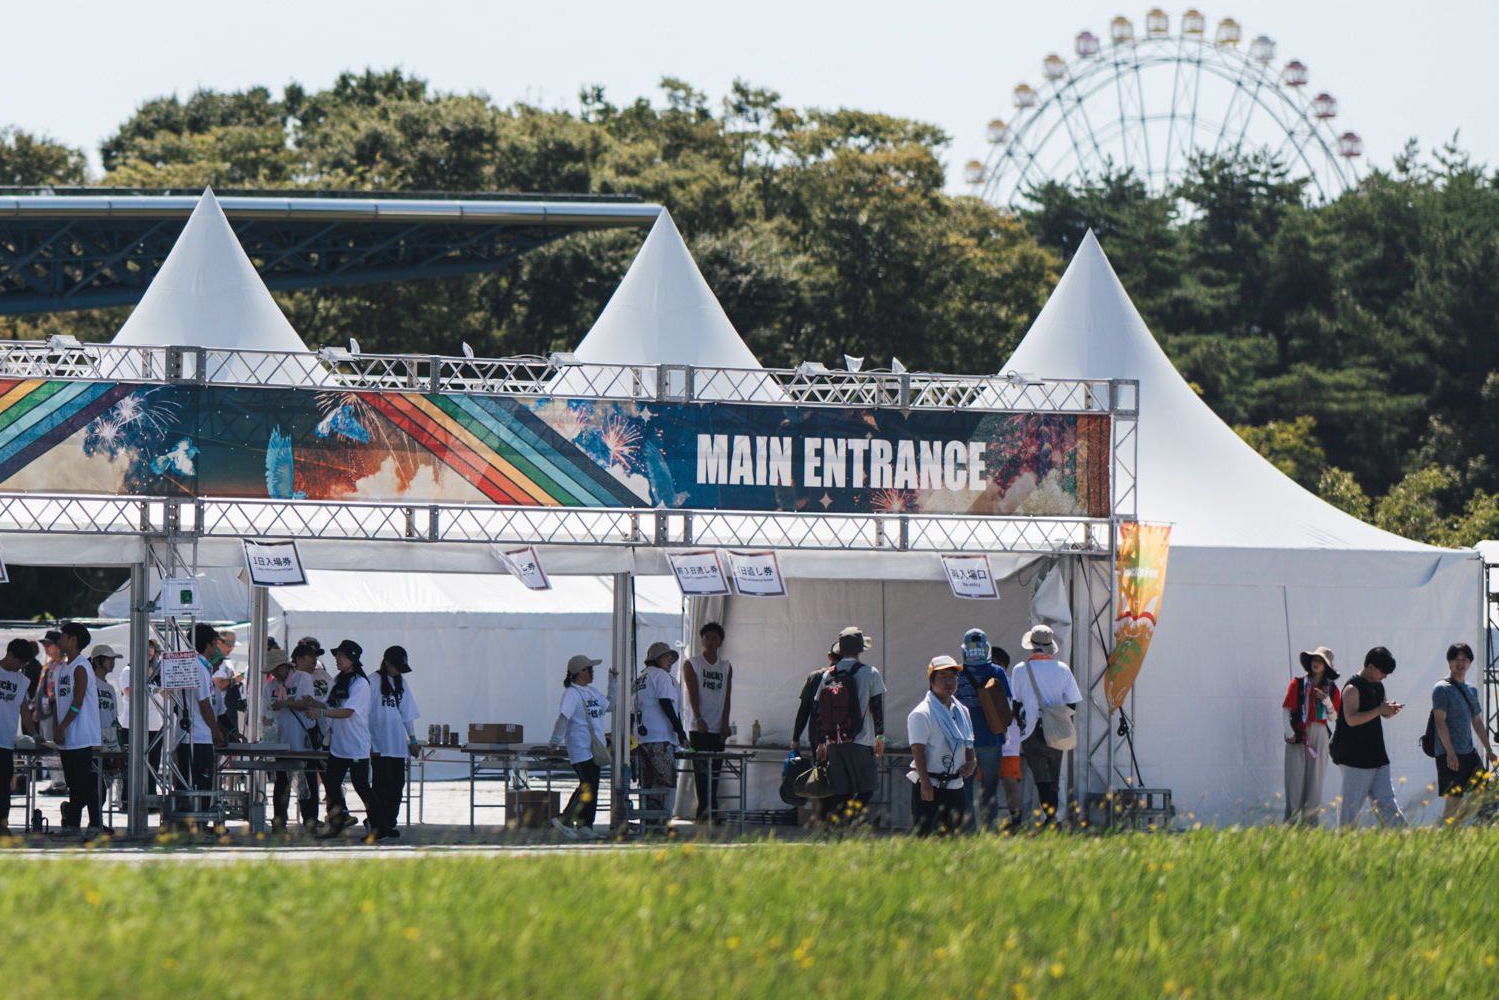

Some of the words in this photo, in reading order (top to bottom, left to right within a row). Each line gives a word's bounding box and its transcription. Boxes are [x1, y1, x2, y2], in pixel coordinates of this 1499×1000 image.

[697, 434, 792, 487] MAIN
[804, 437, 987, 491] ENTRANCE
[253, 556, 292, 567] 1日入場券
[738, 566, 773, 576] 日通し券
[702, 678, 716, 690] Fes
